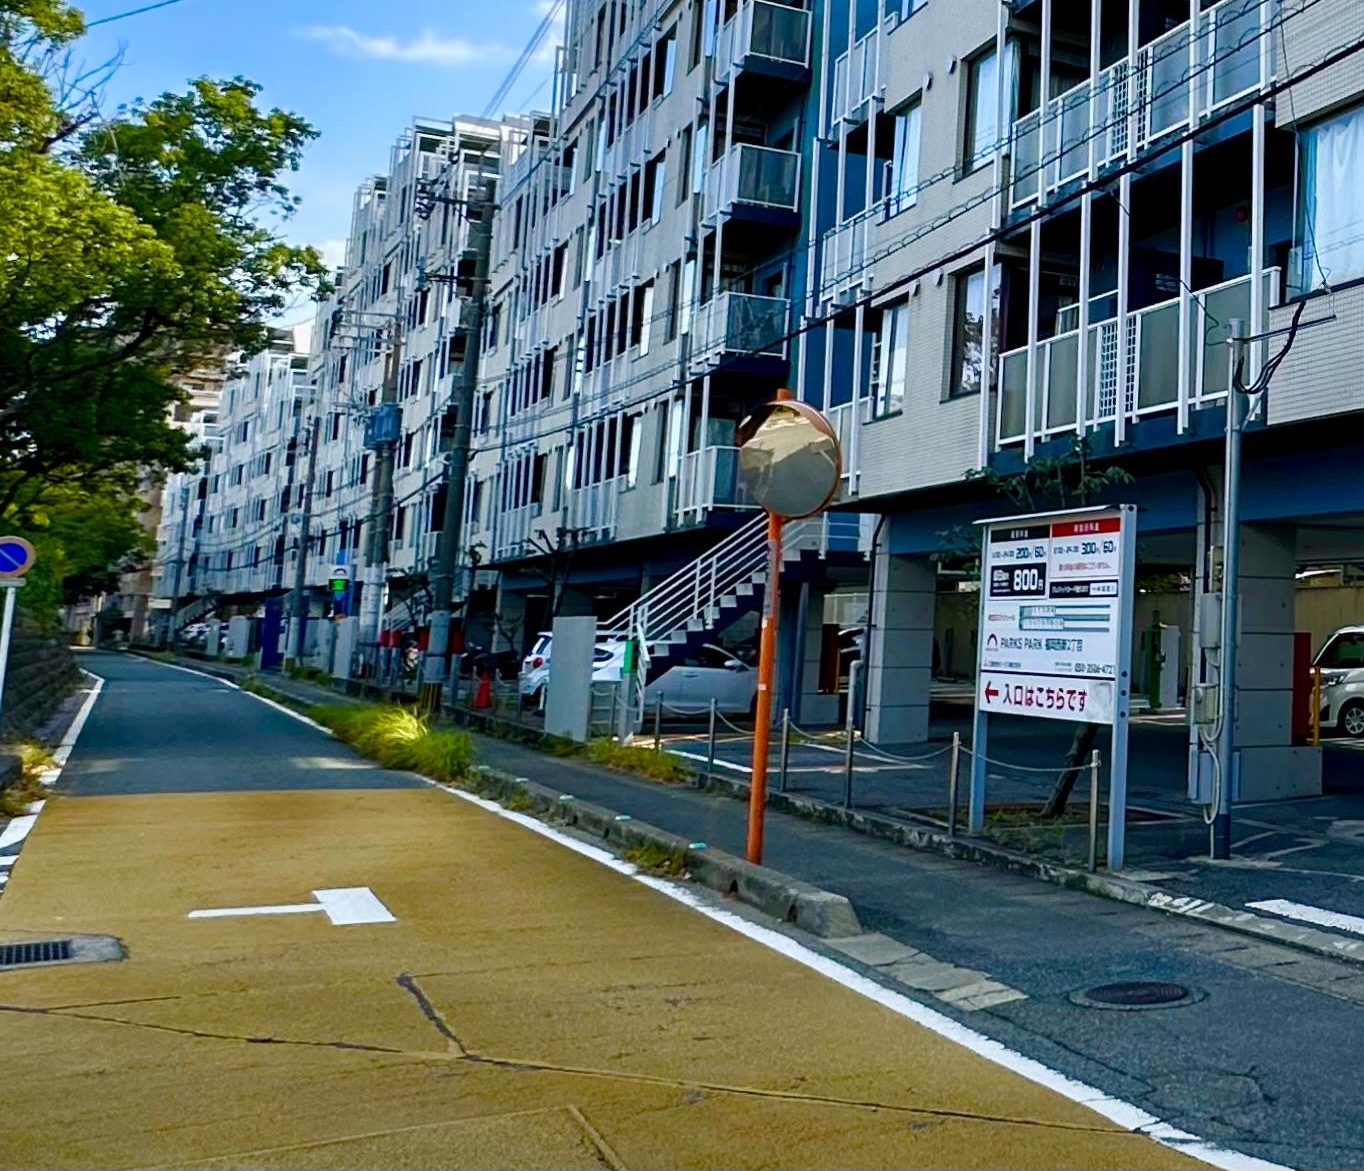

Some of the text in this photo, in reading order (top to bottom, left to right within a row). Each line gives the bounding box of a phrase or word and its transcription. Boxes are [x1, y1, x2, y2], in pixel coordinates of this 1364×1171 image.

[1003, 683, 1088, 711] 入口はこちらです
